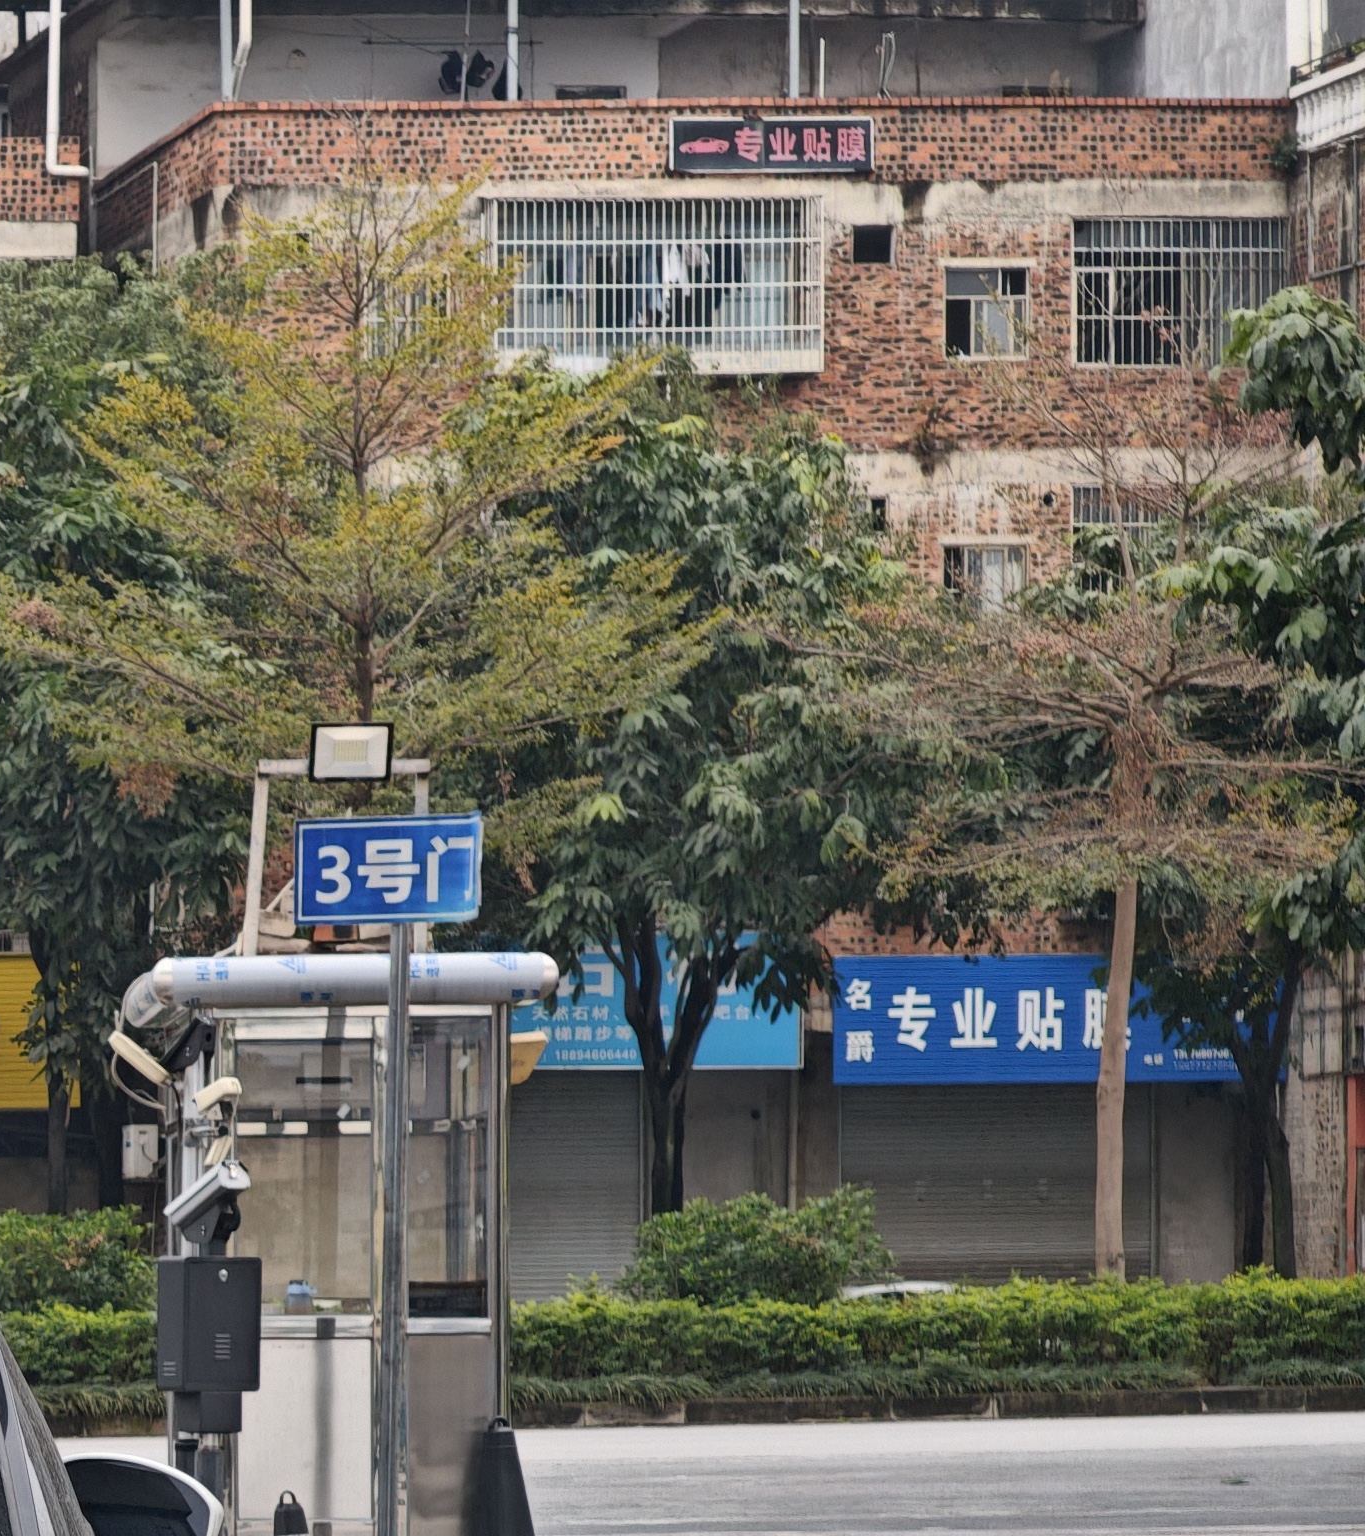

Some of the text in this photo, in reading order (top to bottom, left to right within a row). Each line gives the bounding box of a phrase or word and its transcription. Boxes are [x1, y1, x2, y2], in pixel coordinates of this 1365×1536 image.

[733, 126, 867, 162] 专业贴膜
[314, 834, 475, 905] 3号门
